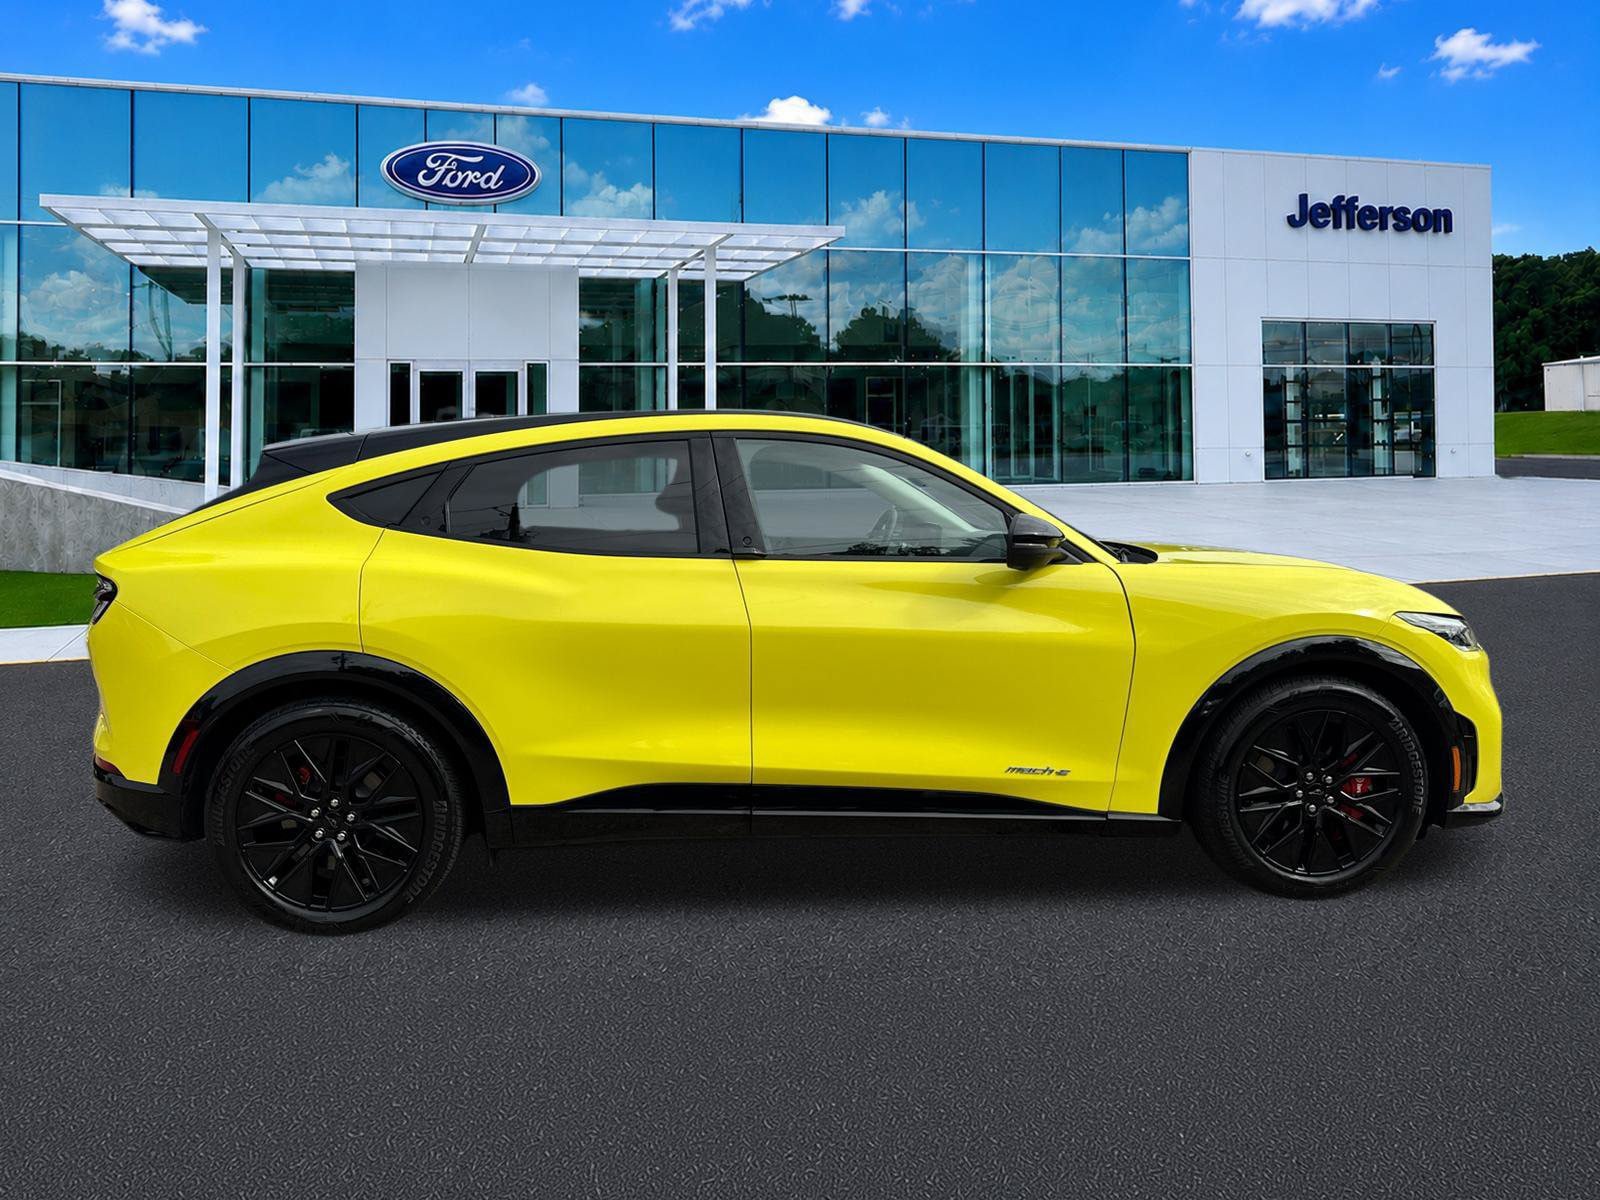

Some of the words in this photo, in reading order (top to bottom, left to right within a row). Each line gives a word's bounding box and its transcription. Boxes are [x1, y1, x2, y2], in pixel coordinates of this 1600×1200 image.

[417, 152, 506, 189] Ford
[1286, 193, 1453, 234] Jefferson
[1388, 717, 1424, 815] BRIDGESTONE
[405, 800, 448, 904] BRIDGESTONE
